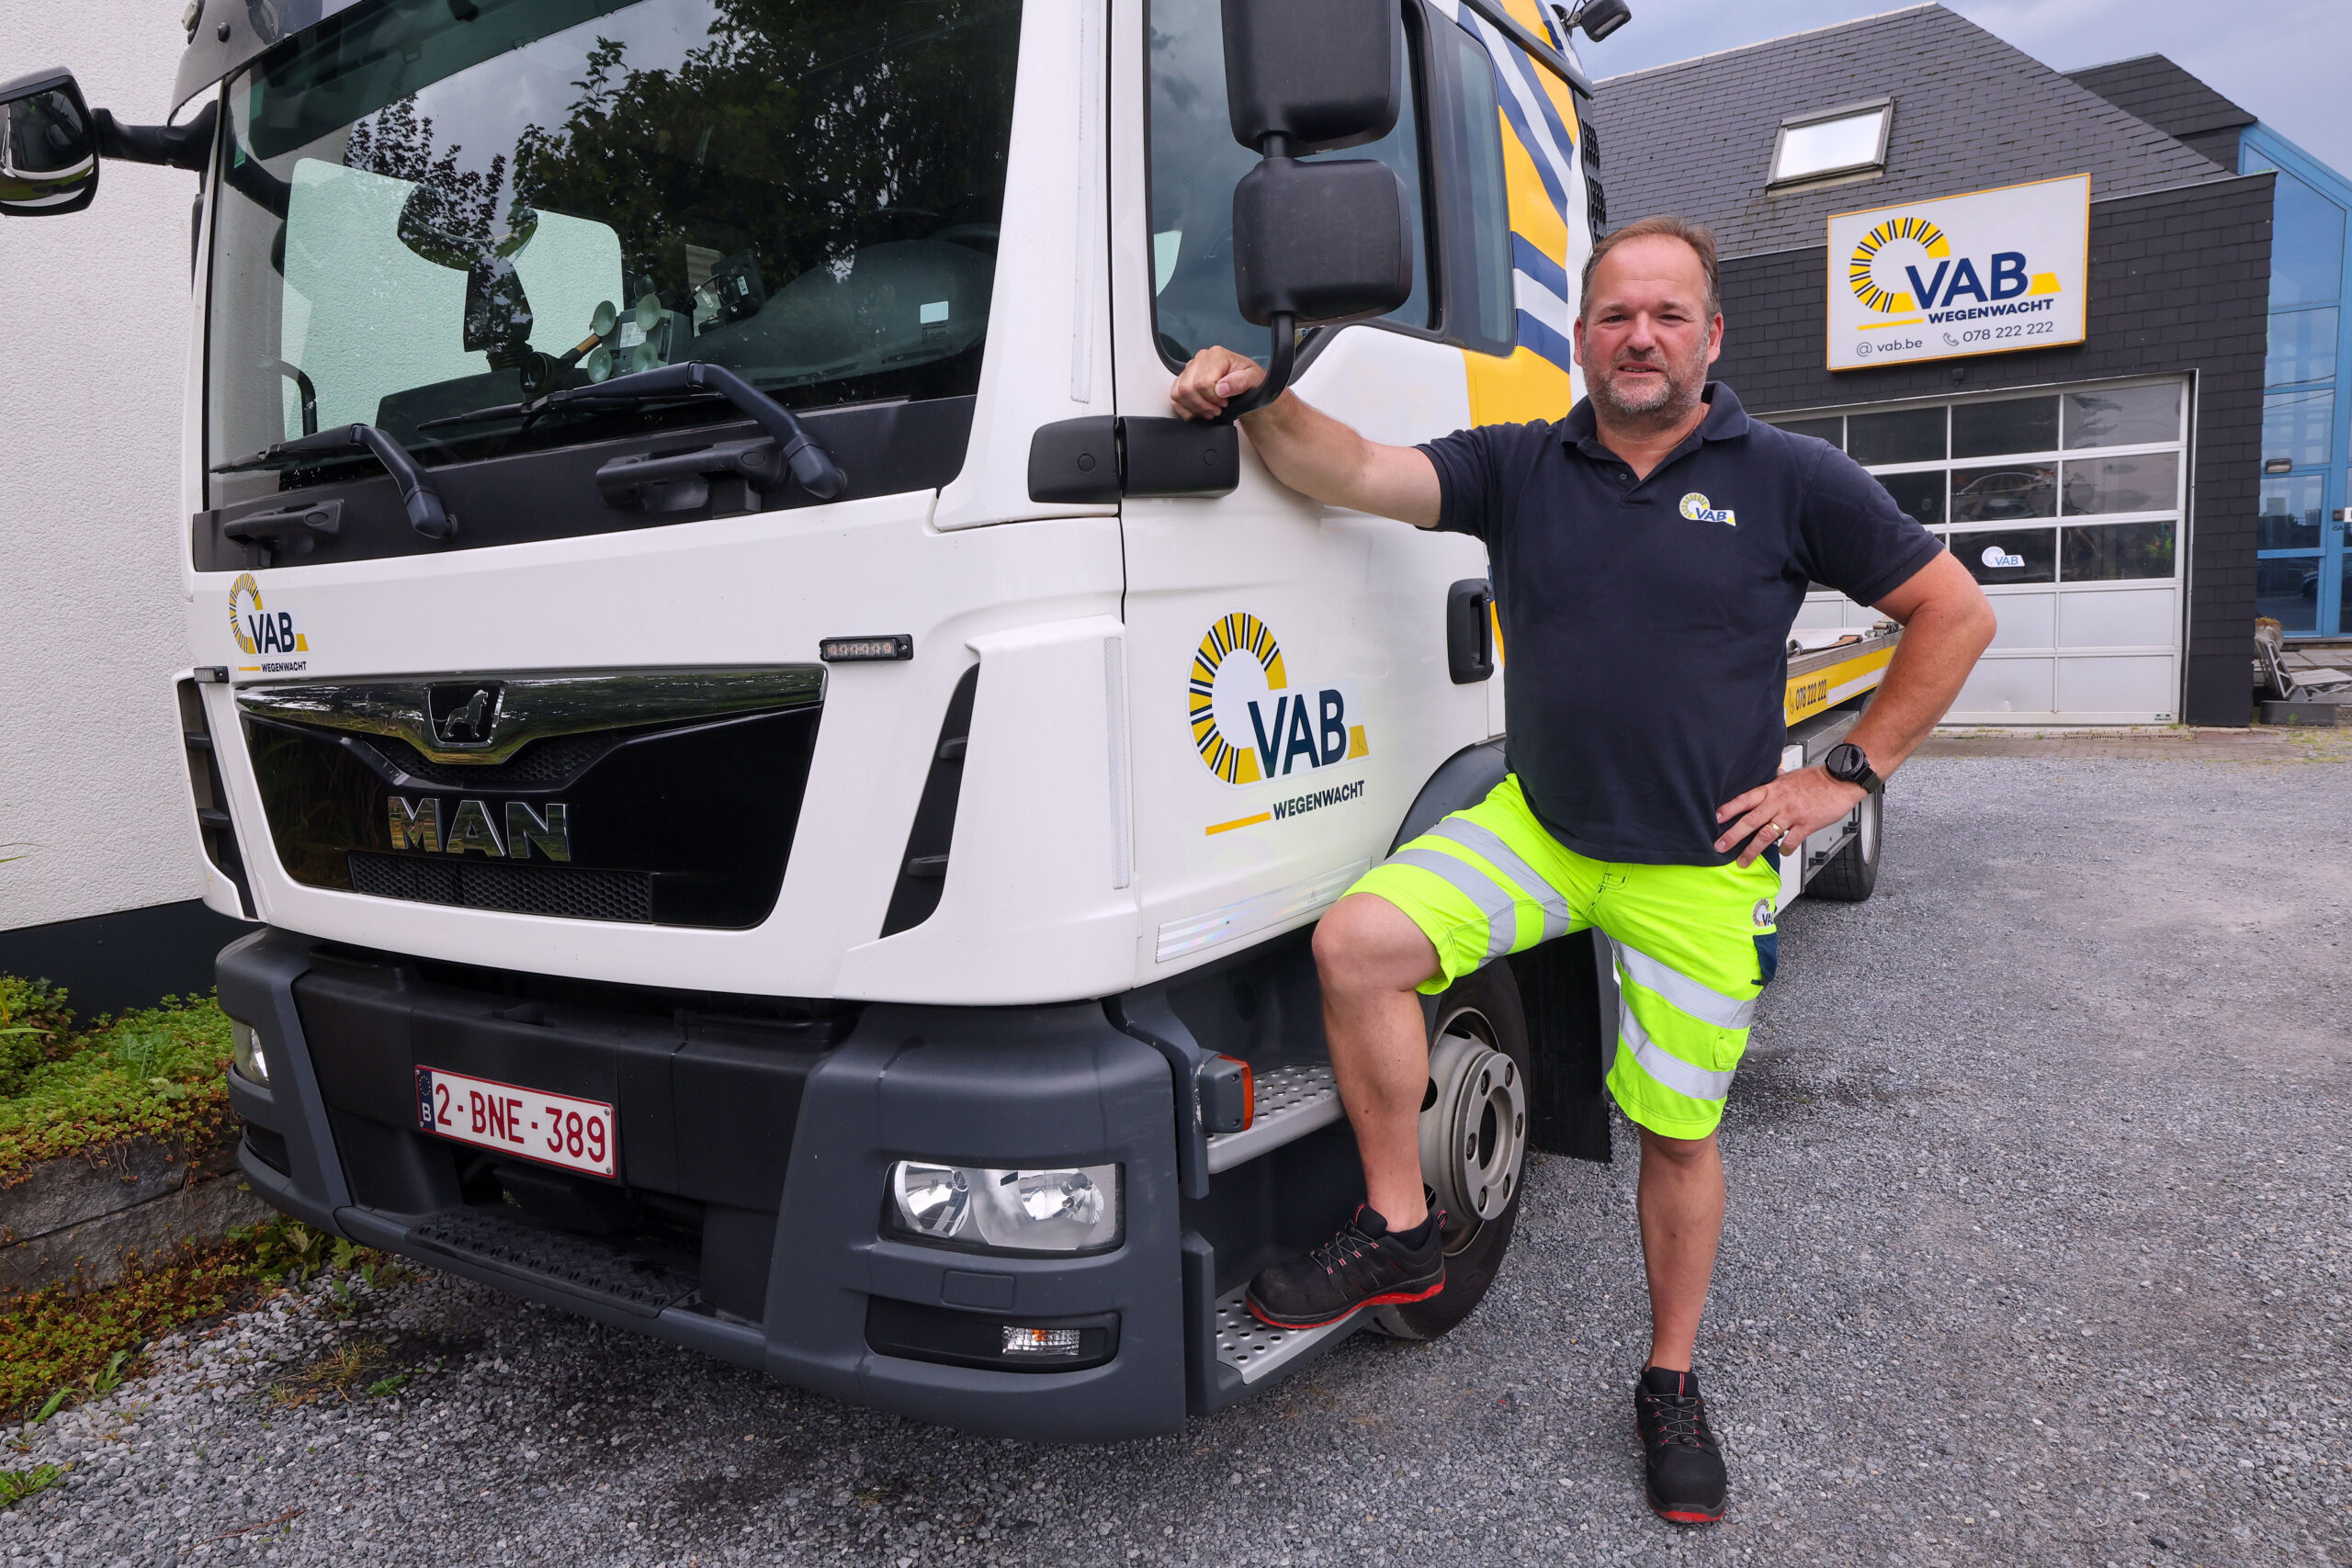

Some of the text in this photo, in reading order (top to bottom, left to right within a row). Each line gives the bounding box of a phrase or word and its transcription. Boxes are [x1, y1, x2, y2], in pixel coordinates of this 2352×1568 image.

[1905, 251, 2029, 310] VAB
[1928, 298, 2054, 324] WEGENWACHT
[1876, 338, 1923, 353] vab.be
[1962, 321, 2054, 343] 078 222 222
[1695, 506, 1727, 522] VAB
[1995, 556, 2019, 566] VAB
[247, 611, 296, 655] VAB
[261, 660, 308, 673] WEGENWACHT
[1795, 678, 1827, 712] 078 222 222
[1247, 688, 1348, 780] VAB
[1272, 779, 1366, 821] WEGENWACHT
[387, 795, 571, 863] MAN
[1762, 912, 1775, 926] VA
[421, 1082, 606, 1164] B 2-BNE-389
